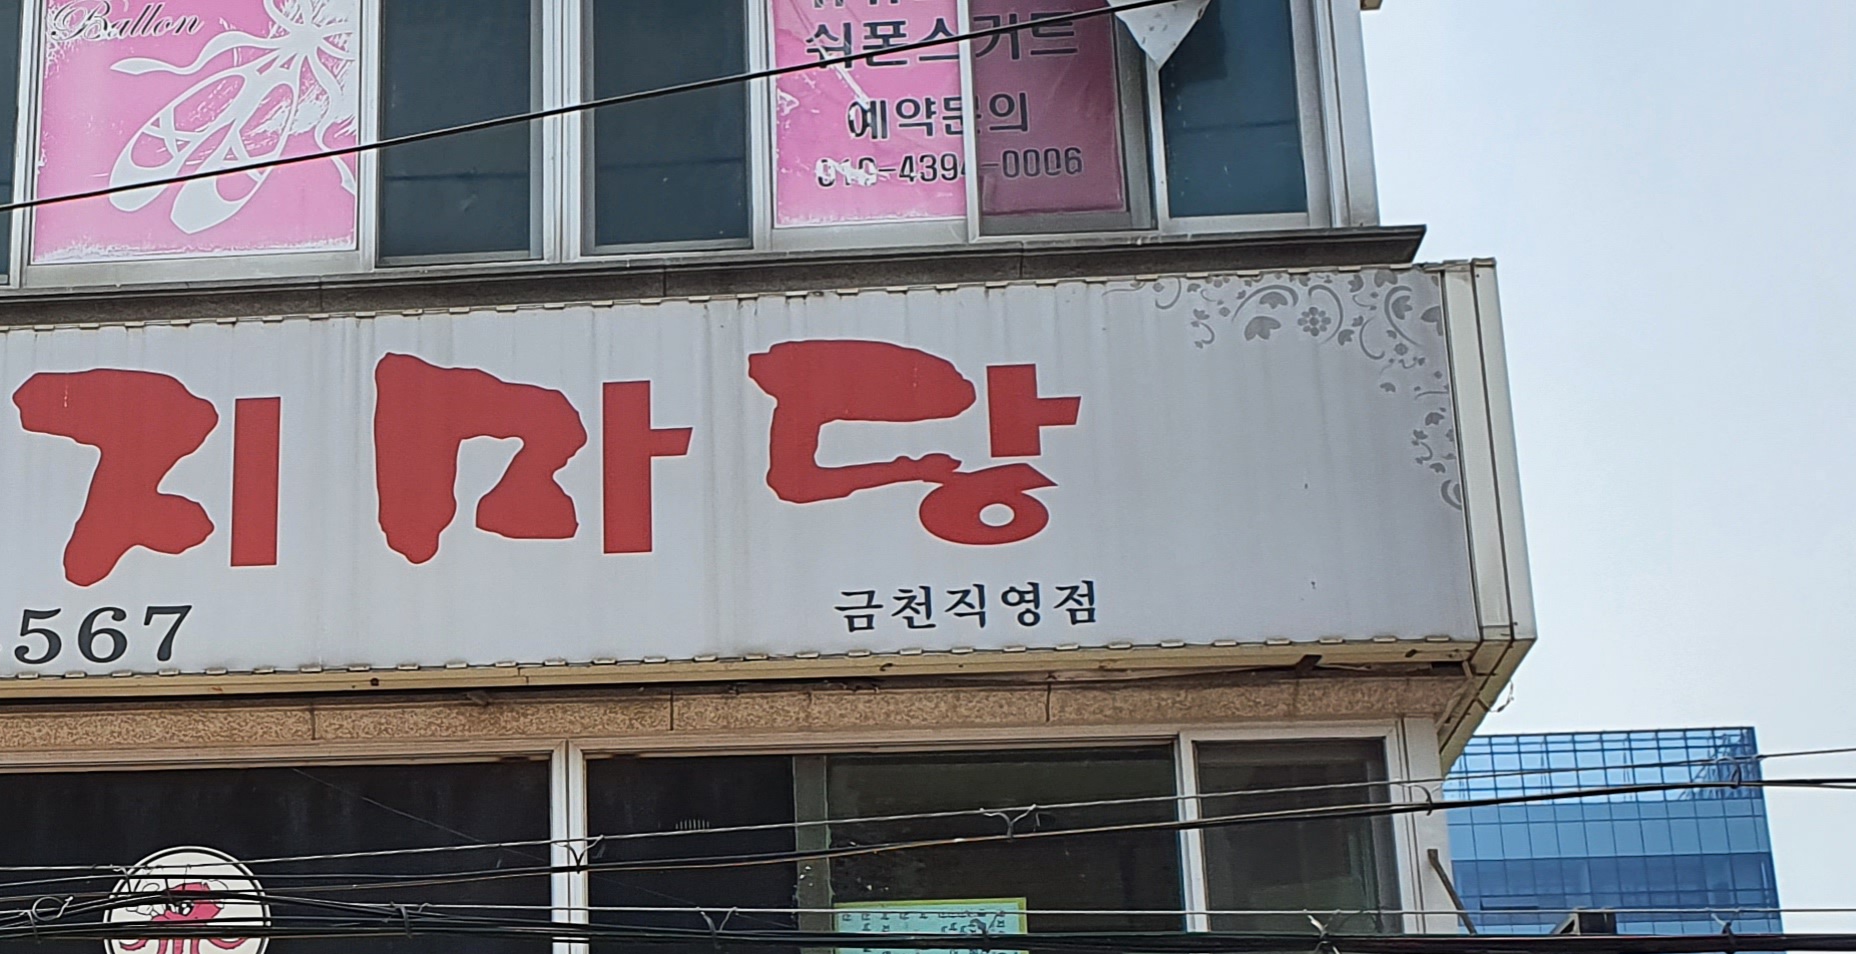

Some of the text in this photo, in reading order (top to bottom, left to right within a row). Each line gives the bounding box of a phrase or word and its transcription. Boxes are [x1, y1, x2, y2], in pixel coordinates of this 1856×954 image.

[50, 0, 202, 40] Ballon
[847, 92, 1029, 140] 예약문의
[816, 146, 1084, 187] 00-439-0006
[831, 579, 1100, 634] 금천직영점
